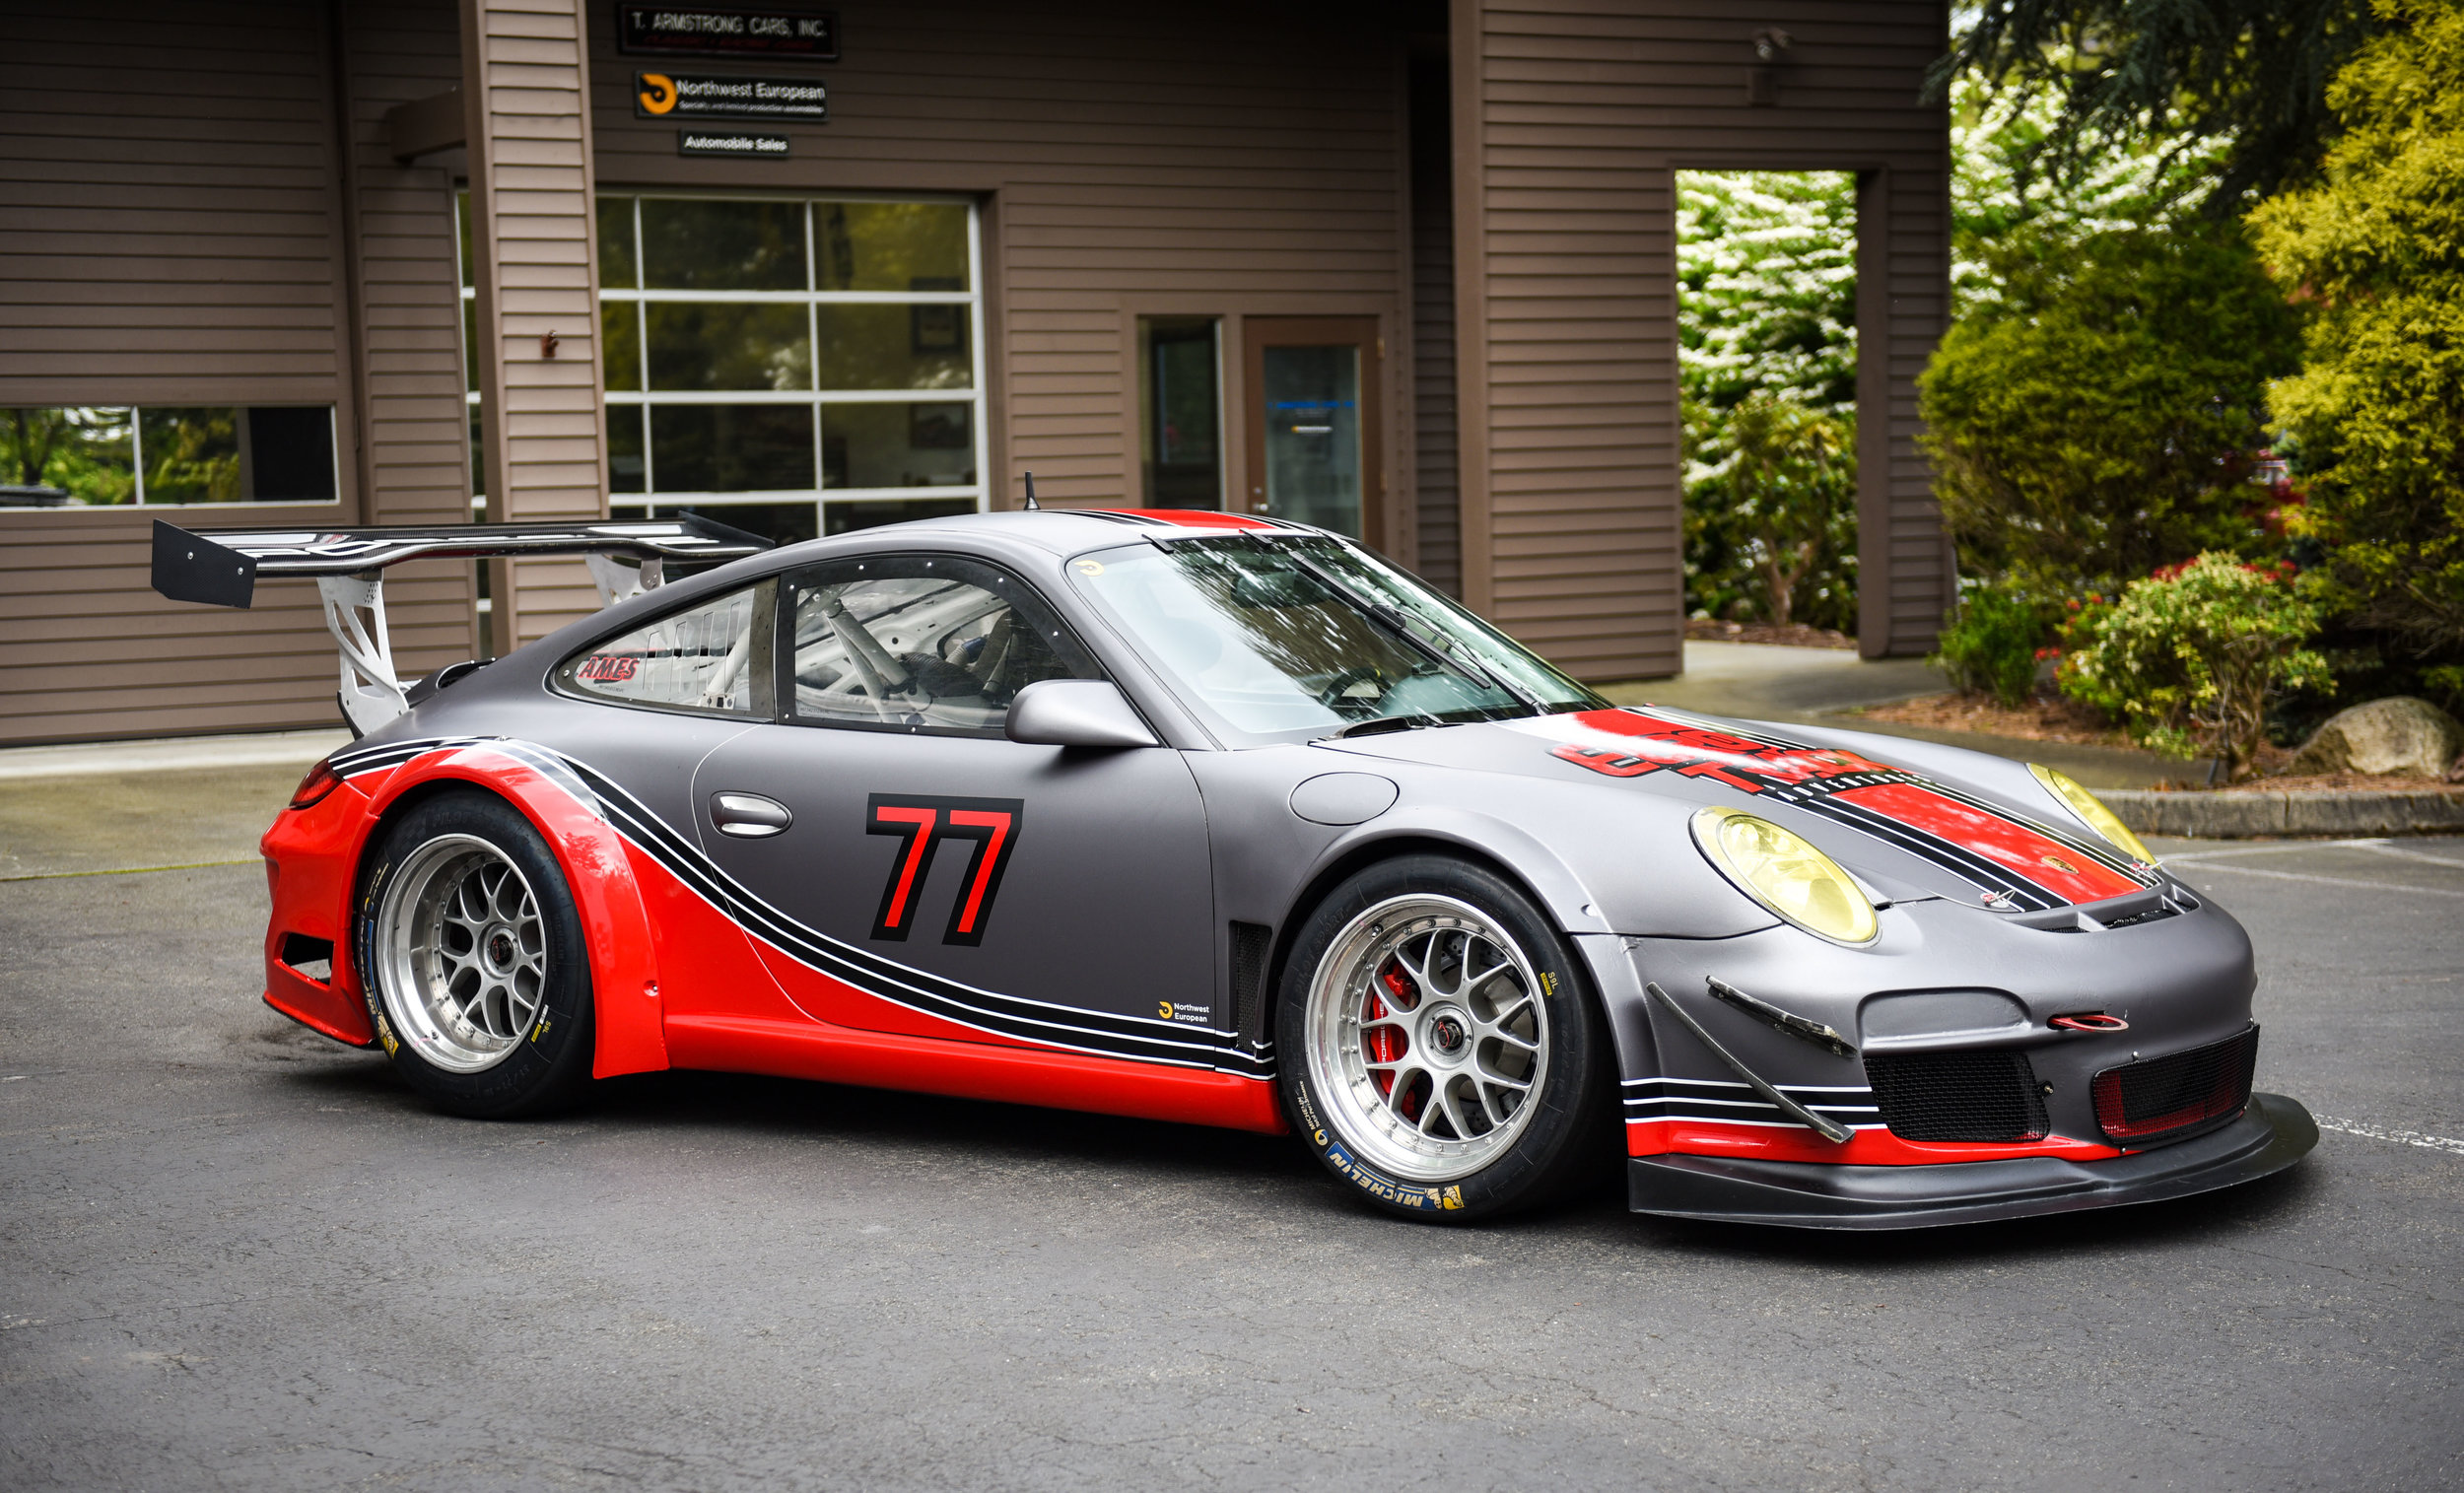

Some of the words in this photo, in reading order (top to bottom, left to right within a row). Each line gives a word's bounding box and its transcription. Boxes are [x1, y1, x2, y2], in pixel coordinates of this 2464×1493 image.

[651, 13, 744, 34] ARMSTRONG
[749, 16, 793, 37] CARS,
[797, 19, 827, 36] INC.
[675, 79, 753, 97] Northwest
[755, 83, 826, 102] European
[684, 136, 754, 150] Automobile
[755, 138, 788, 152] Sales
[578, 655, 640, 681] AMES
[866, 792, 1024, 947] 77
[1547, 971, 1557, 990] S9L
[1173, 1002, 1210, 1014] Northwest
[1174, 1012, 1208, 1023] European
[1329, 1152, 1425, 1208] MICHELIN
